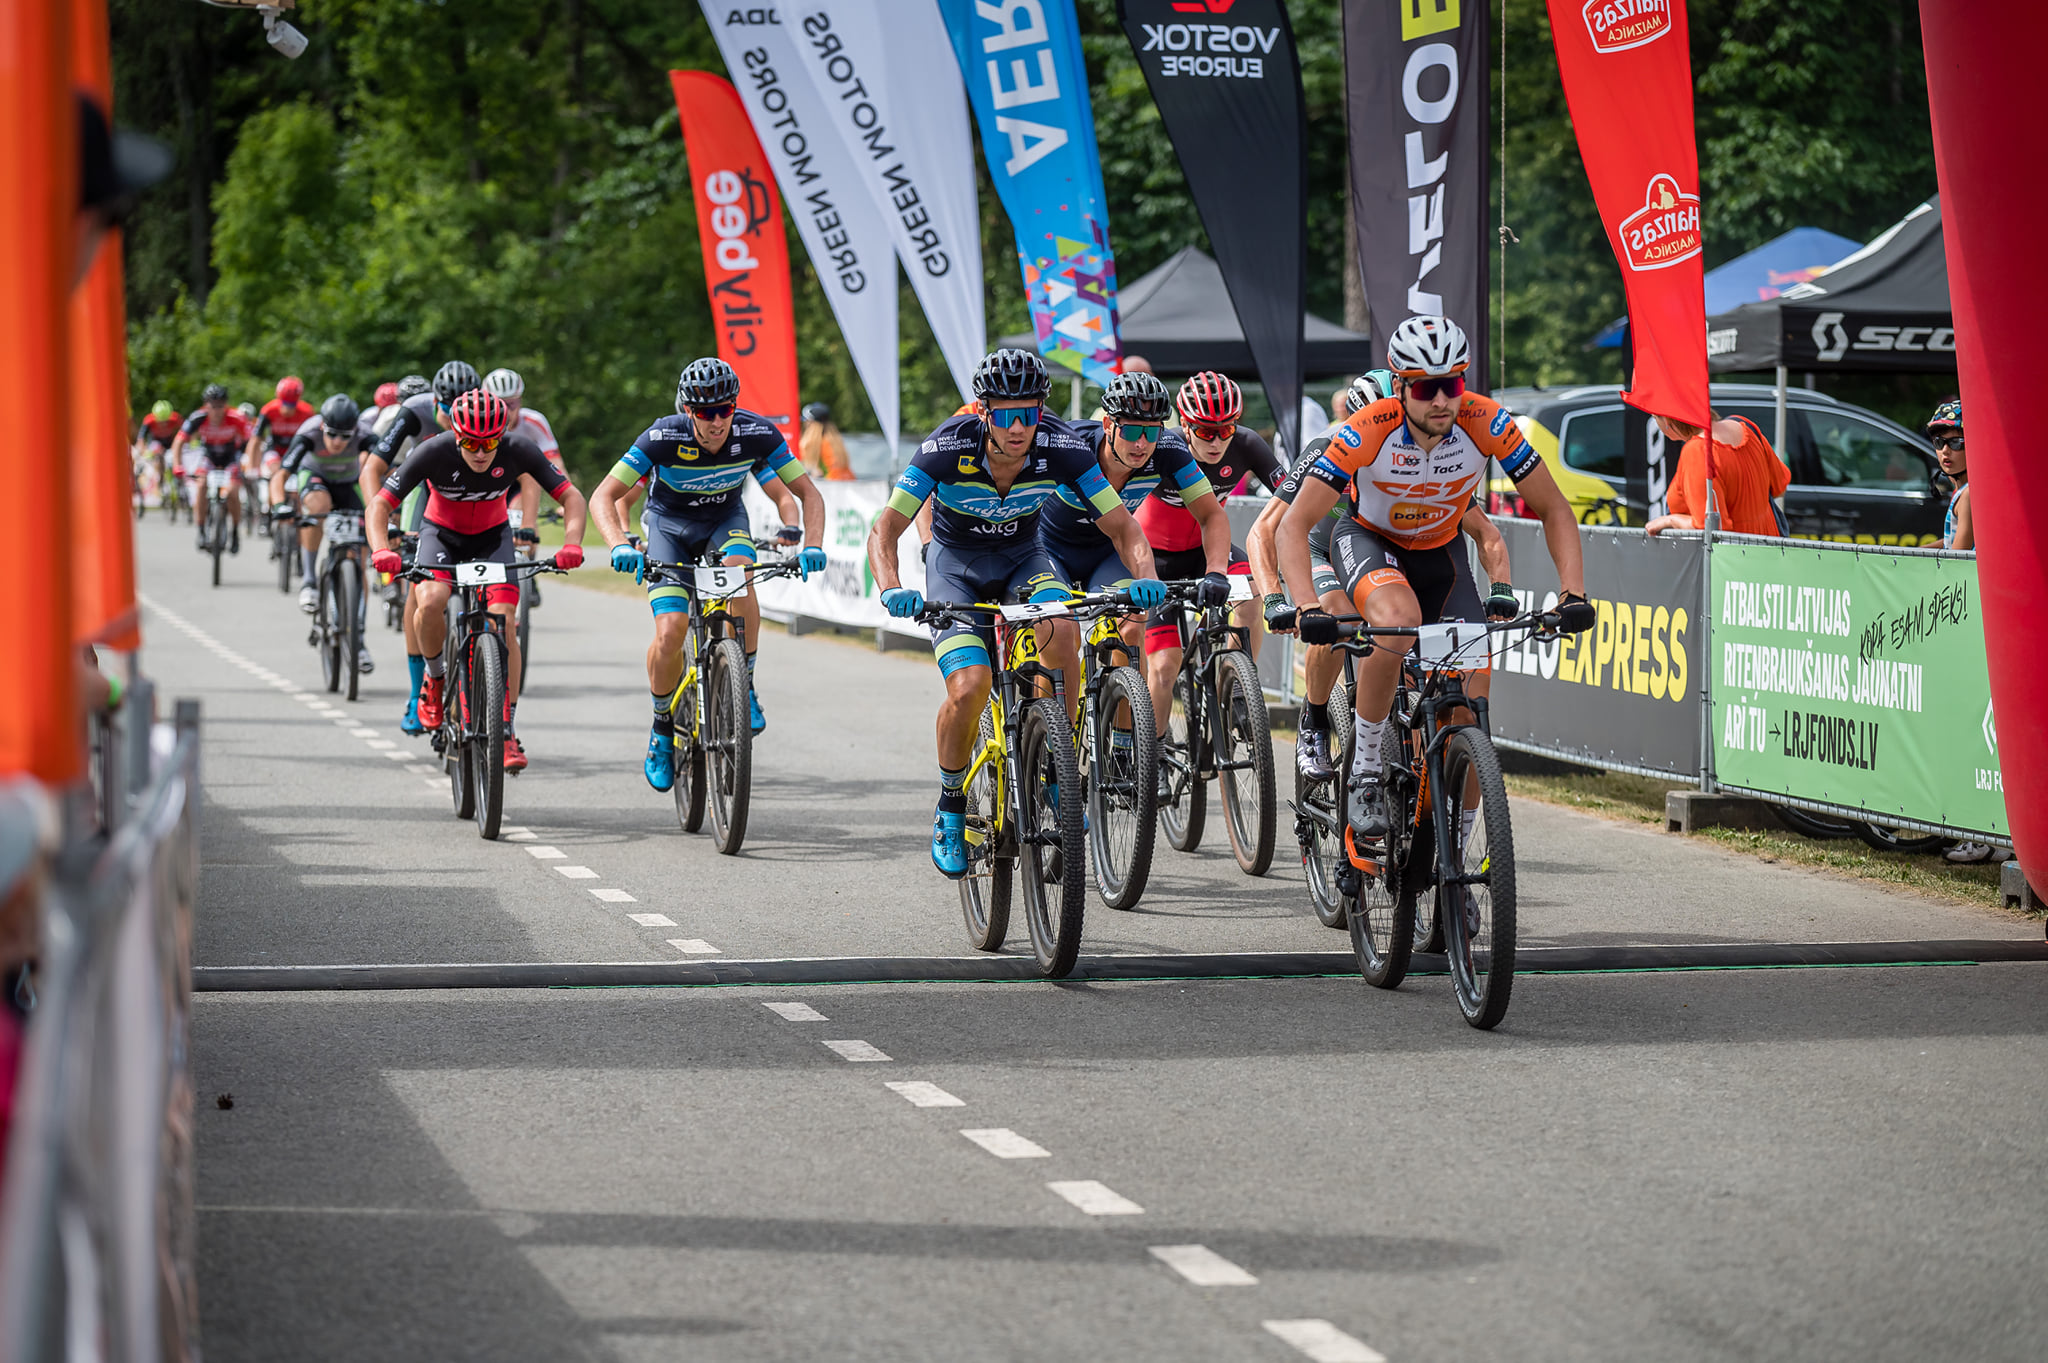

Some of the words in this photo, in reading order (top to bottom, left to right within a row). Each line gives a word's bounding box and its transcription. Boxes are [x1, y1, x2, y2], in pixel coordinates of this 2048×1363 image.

[1492, 410, 1508, 434] KMC
[1340, 427, 1360, 446] KMC
[1291, 449, 1322, 481] Dobele
[1434, 449, 1464, 461] GARMIN
[1433, 462, 1464, 475] Tacx
[1372, 471, 1478, 498] CST
[474, 564, 487, 576] 9
[713, 570, 728, 587] 5
[1023, 604, 1043, 613] 3
[1722, 581, 1784, 630] ATBALSTI
[1787, 586, 1851, 637] LATVIJAS
[1891, 597, 1924, 650] ESAM
[1446, 627, 1459, 653] 1
[1852, 656, 1922, 712] JAUNATNI
[1724, 696, 1748, 750] ARĪ
[1749, 706, 1766, 753] TU
[1784, 710, 1878, 771] LRJFONDS.LV
[1975, 768, 1993, 790] LRJ
